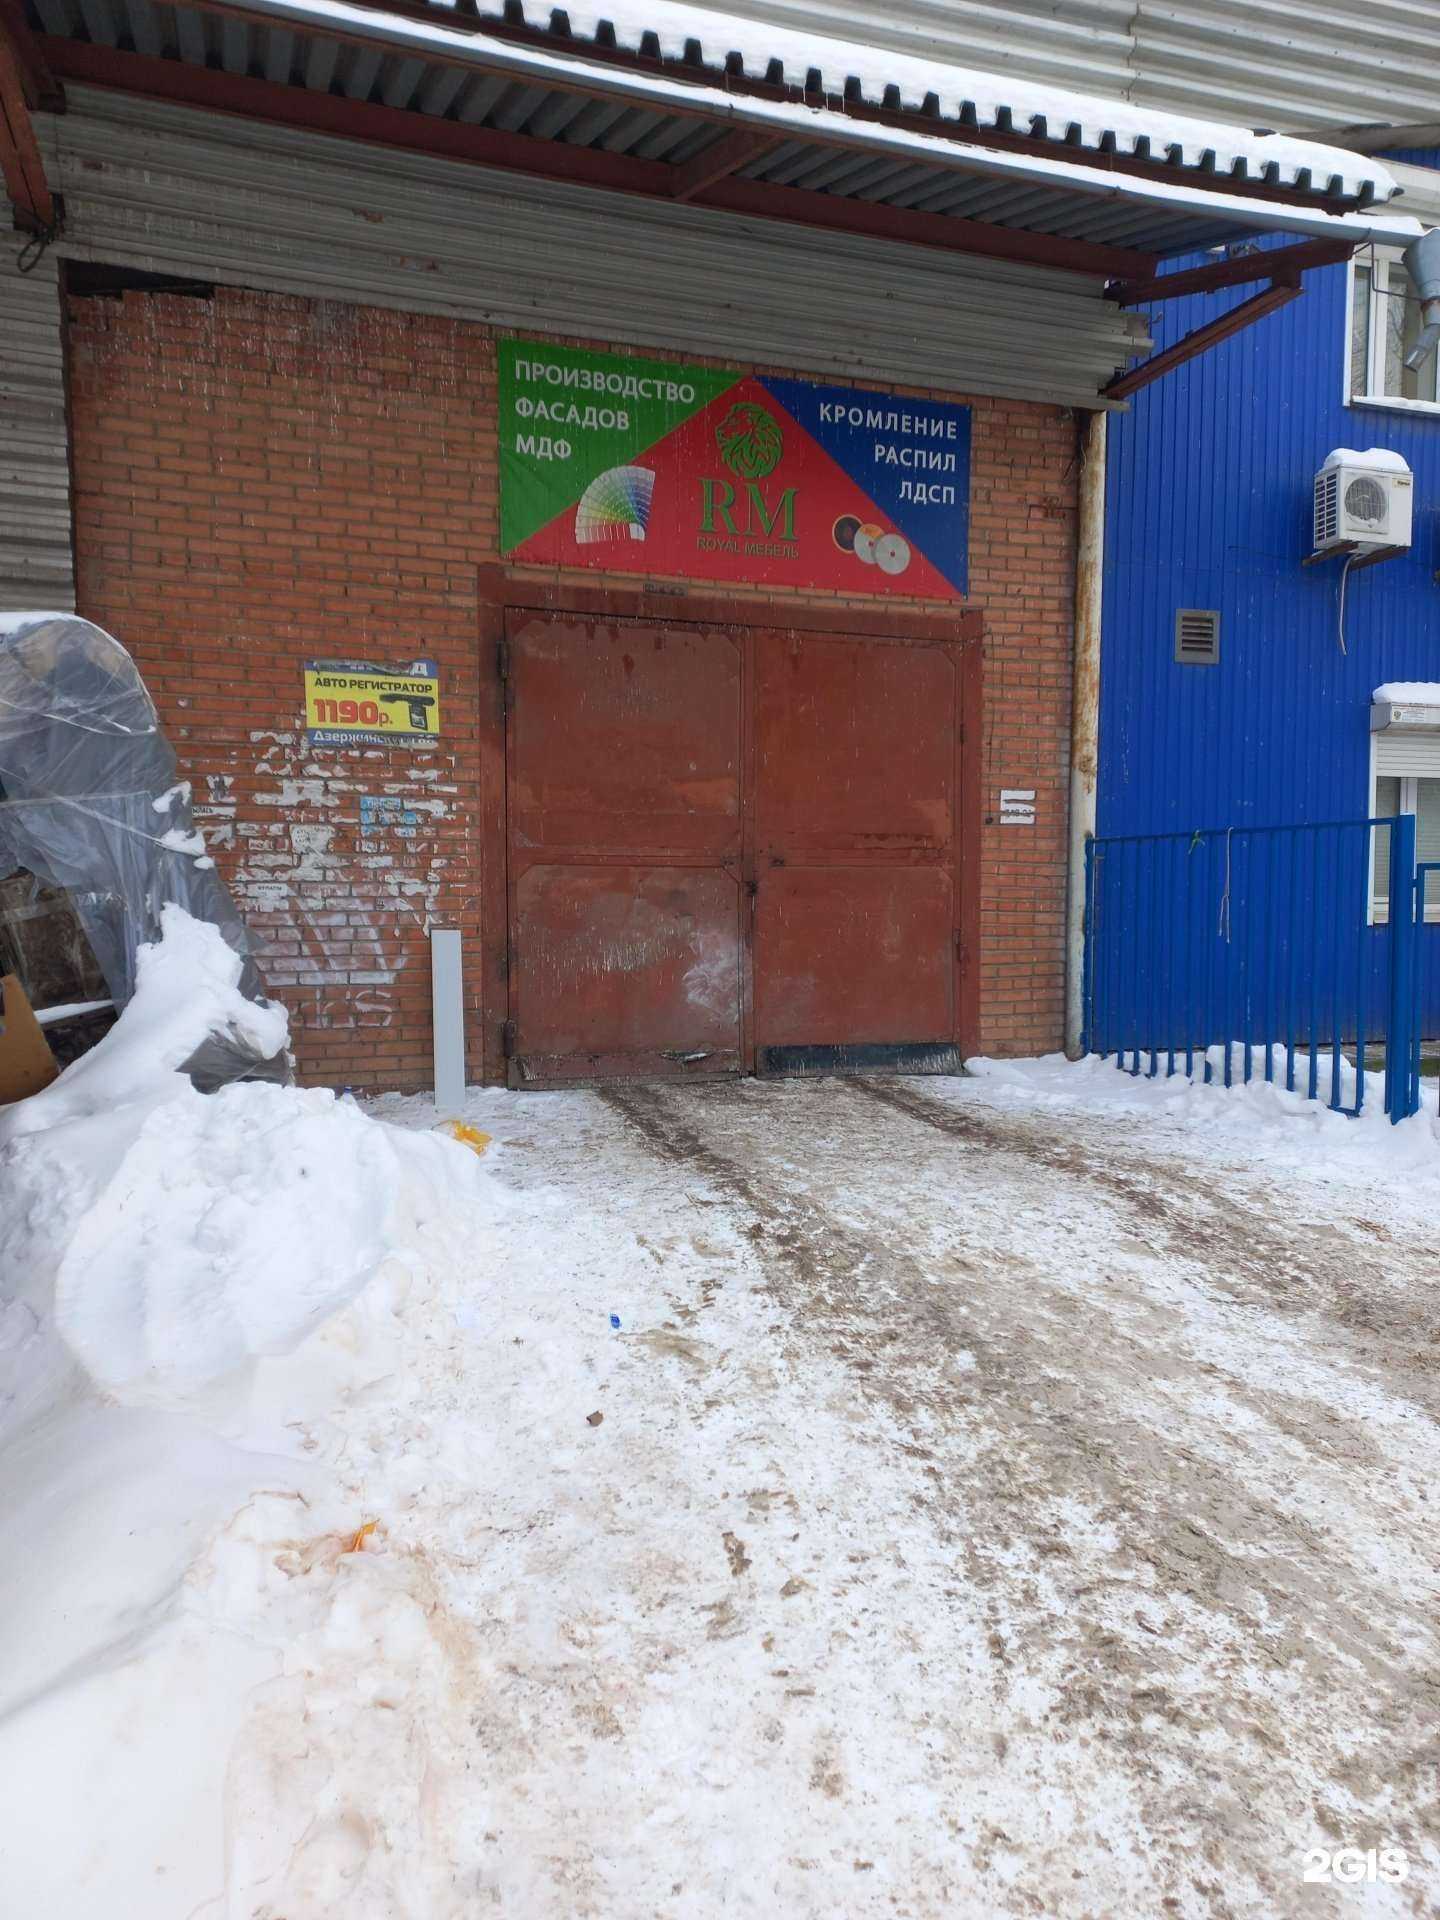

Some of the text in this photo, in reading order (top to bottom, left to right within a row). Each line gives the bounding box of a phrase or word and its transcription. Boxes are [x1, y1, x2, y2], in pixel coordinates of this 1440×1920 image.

[514, 359, 695, 404] ПРОИЗВОДСТВО
[514, 396, 630, 431] ФАСАДОВ
[819, 402, 958, 440] КРОМЛЕНИЕ
[515, 433, 573, 461] МДФ
[874, 444, 956, 473] РАСПИЛ
[898, 480, 956, 505] ЛДСП
[697, 478, 799, 542] RM
[696, 535, 800, 561] ROYAL МЕБЕЛЬ
[314, 677, 433, 694] АВТО РЕГИСТРАТОР
